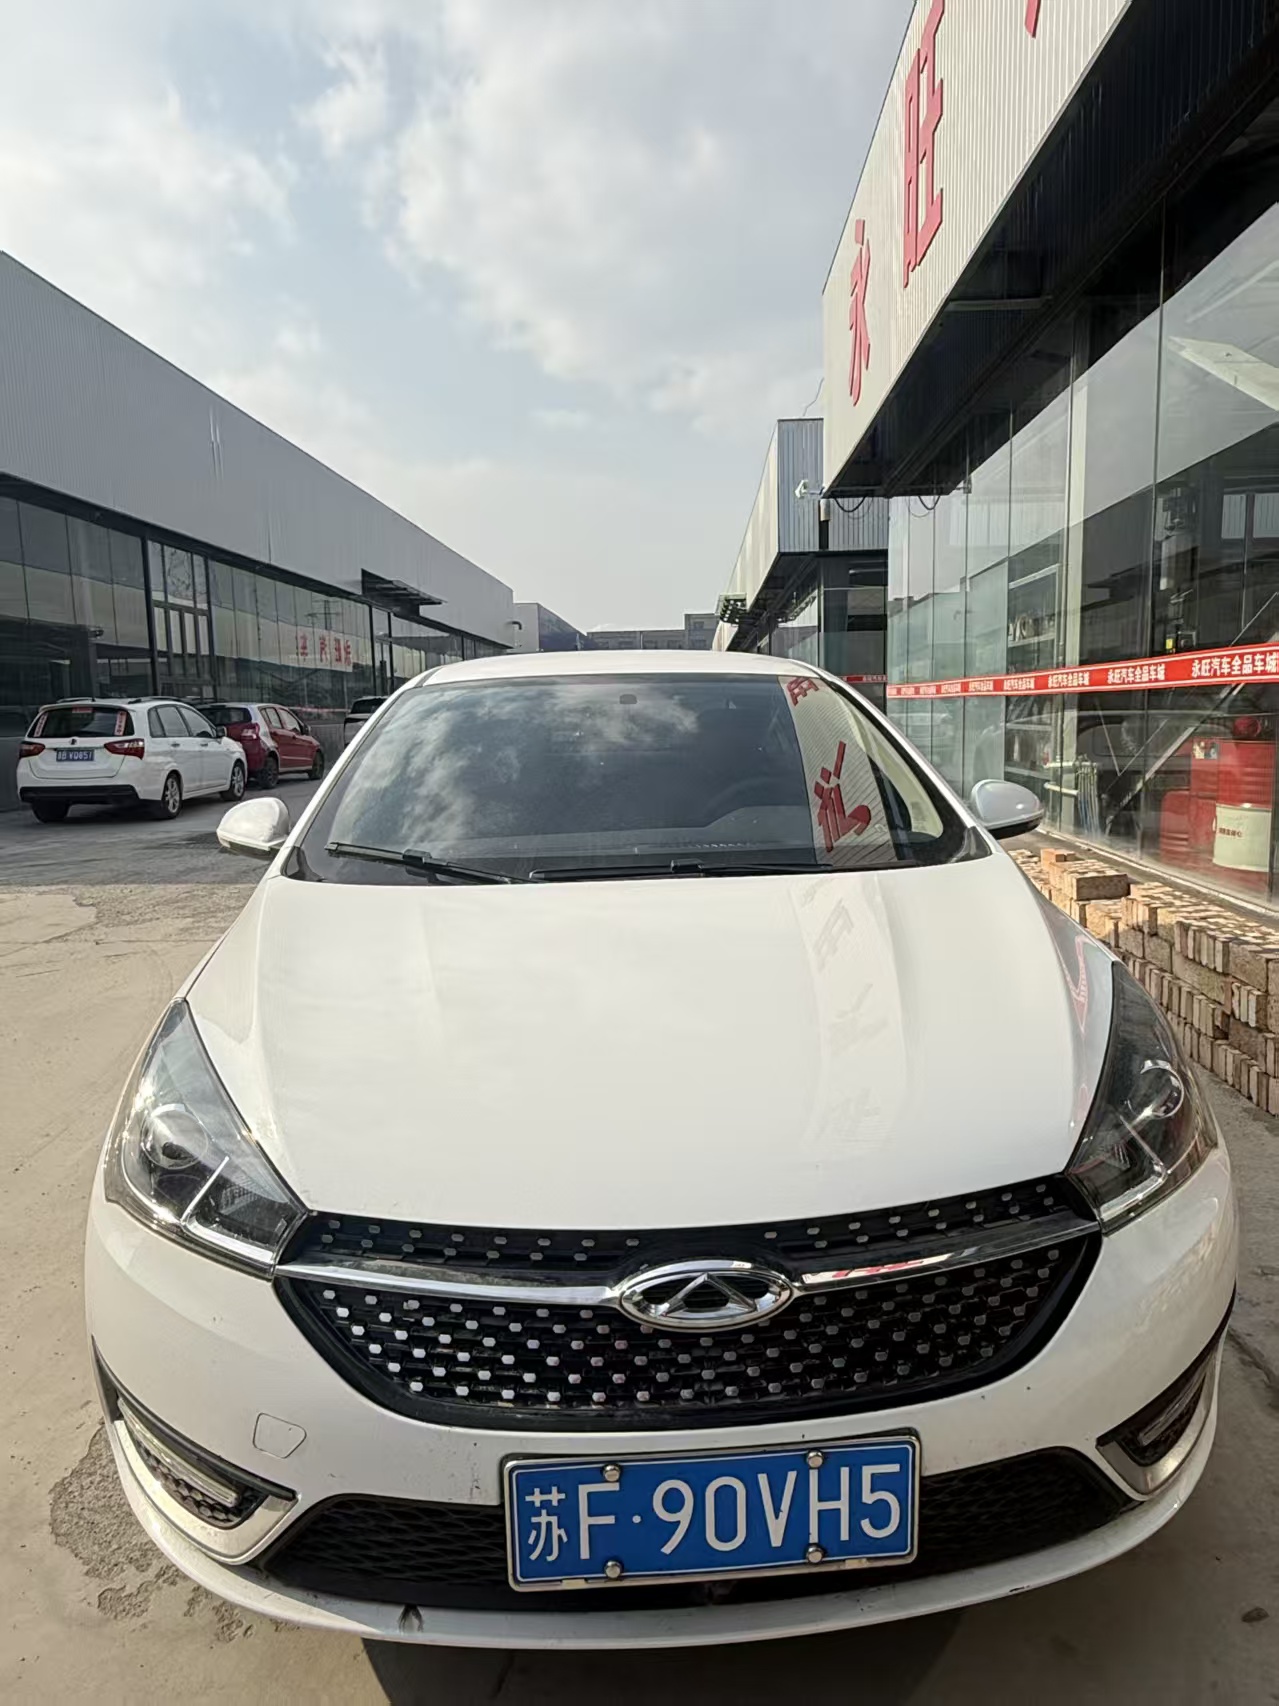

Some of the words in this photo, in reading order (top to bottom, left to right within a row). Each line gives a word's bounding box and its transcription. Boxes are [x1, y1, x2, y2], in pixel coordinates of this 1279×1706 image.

[1107, 664, 1166, 684] 永旺汽车全品车城
[1192, 652, 1278, 677] 永旺汽车全品车城
[525, 1463, 900, 1562] 苏F·90VH5
